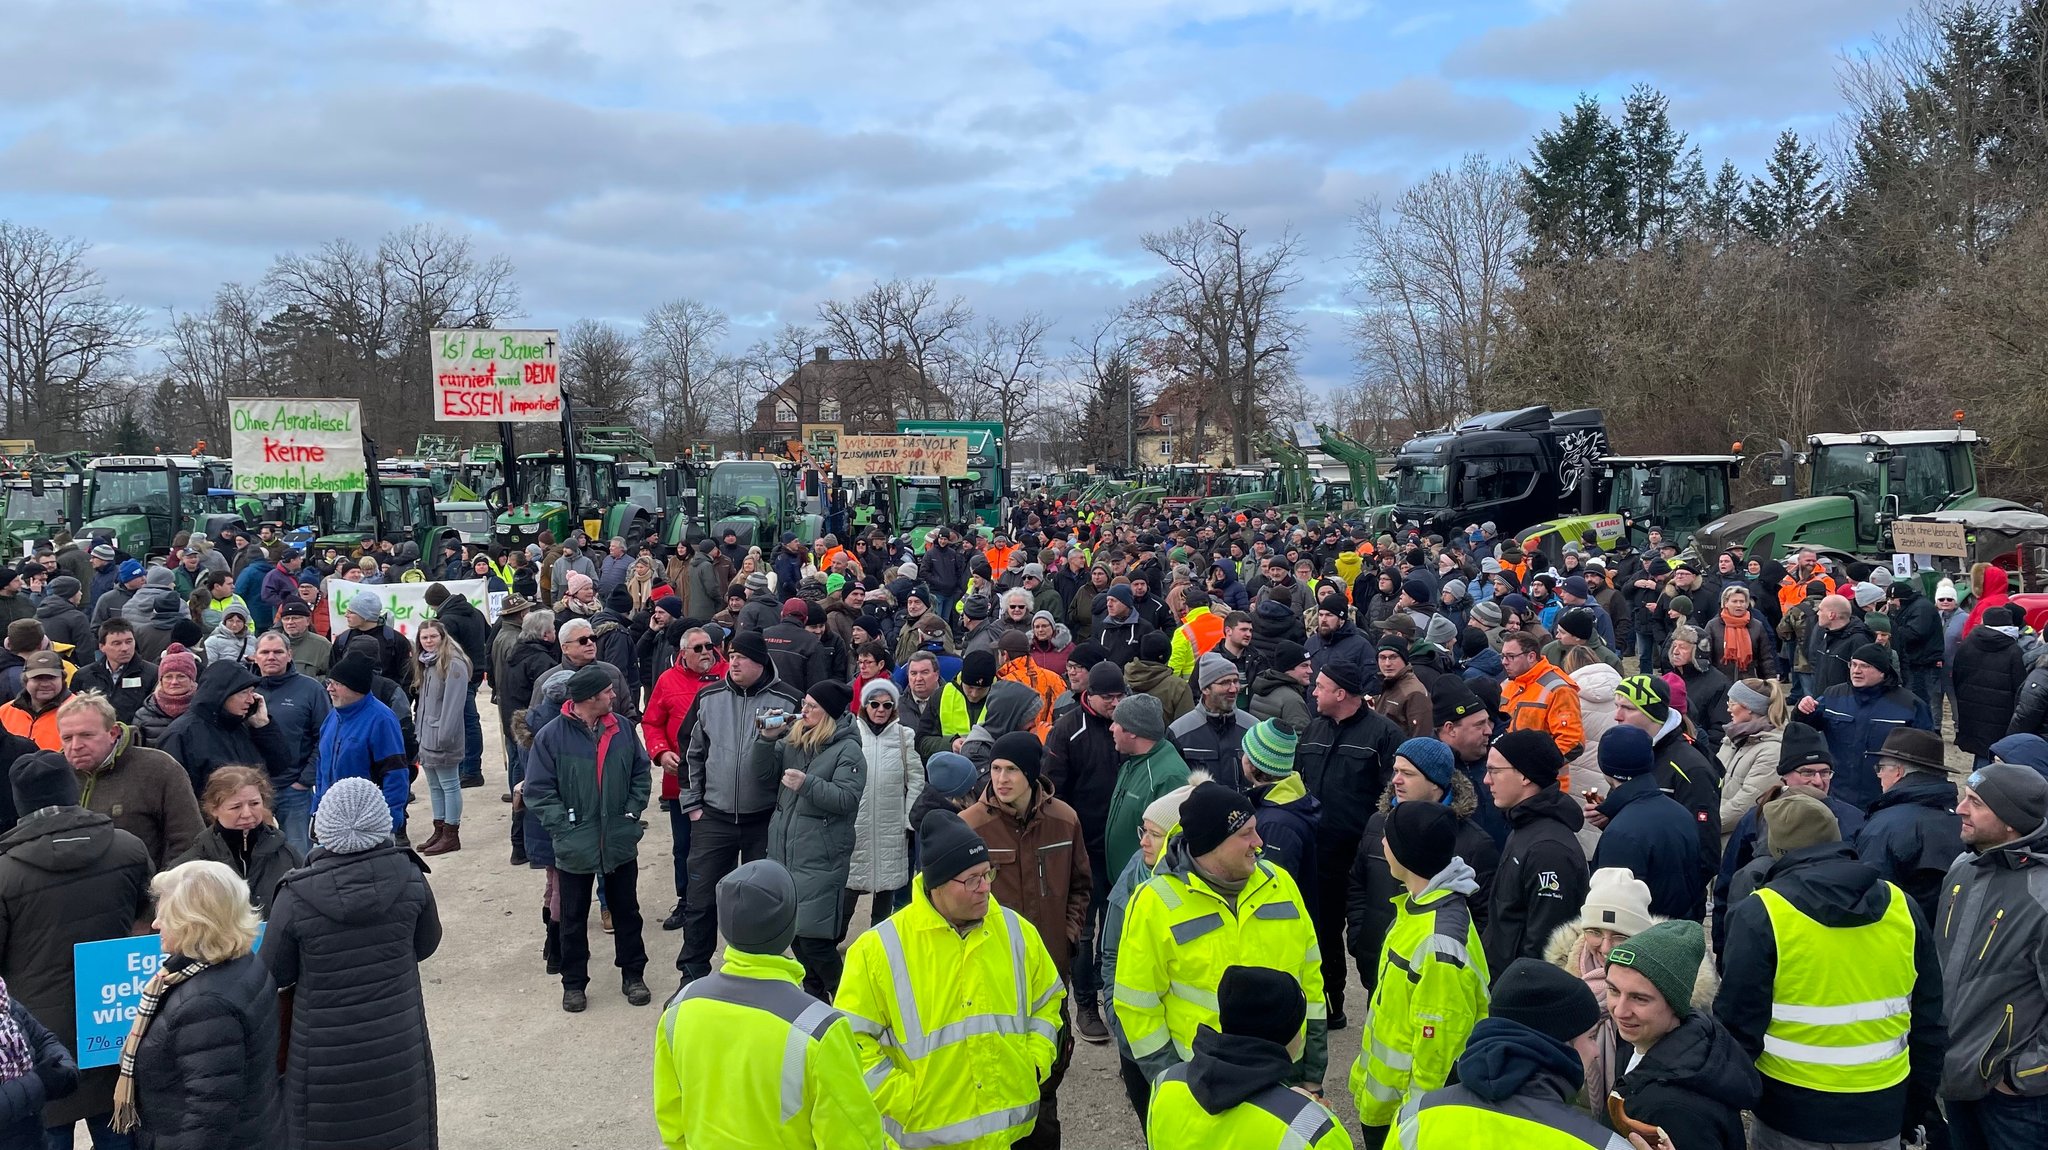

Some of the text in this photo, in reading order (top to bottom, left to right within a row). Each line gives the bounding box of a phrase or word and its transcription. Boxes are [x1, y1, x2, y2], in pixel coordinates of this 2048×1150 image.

[442, 333, 466, 359] Ist
[472, 338, 496, 359] der
[497, 371, 521, 386] wird
[524, 362, 556, 385] DEIN
[444, 390, 560, 416] ESSEN importiert
[234, 406, 352, 432] Ohne Agrardiesel
[263, 436, 325, 463] Keine
[840, 449, 898, 460] ZUSAMMEN
[926, 451, 952, 461] WIR
[923, 438, 958, 450] VOLK
[864, 460, 904, 472] STARK
[235, 465, 366, 492] regionalen Lebensmittel
[1596, 519, 1620, 529] CLAAS
[1892, 523, 1916, 536] Politik
[1917, 525, 1932, 536] ohne
[385, 594, 414, 620] der
[1537, 871, 1560, 891] VTS
[127, 952, 171, 975] Ega
[101, 976, 147, 1005] gek
[86, 1034, 110, 1050] 7%
